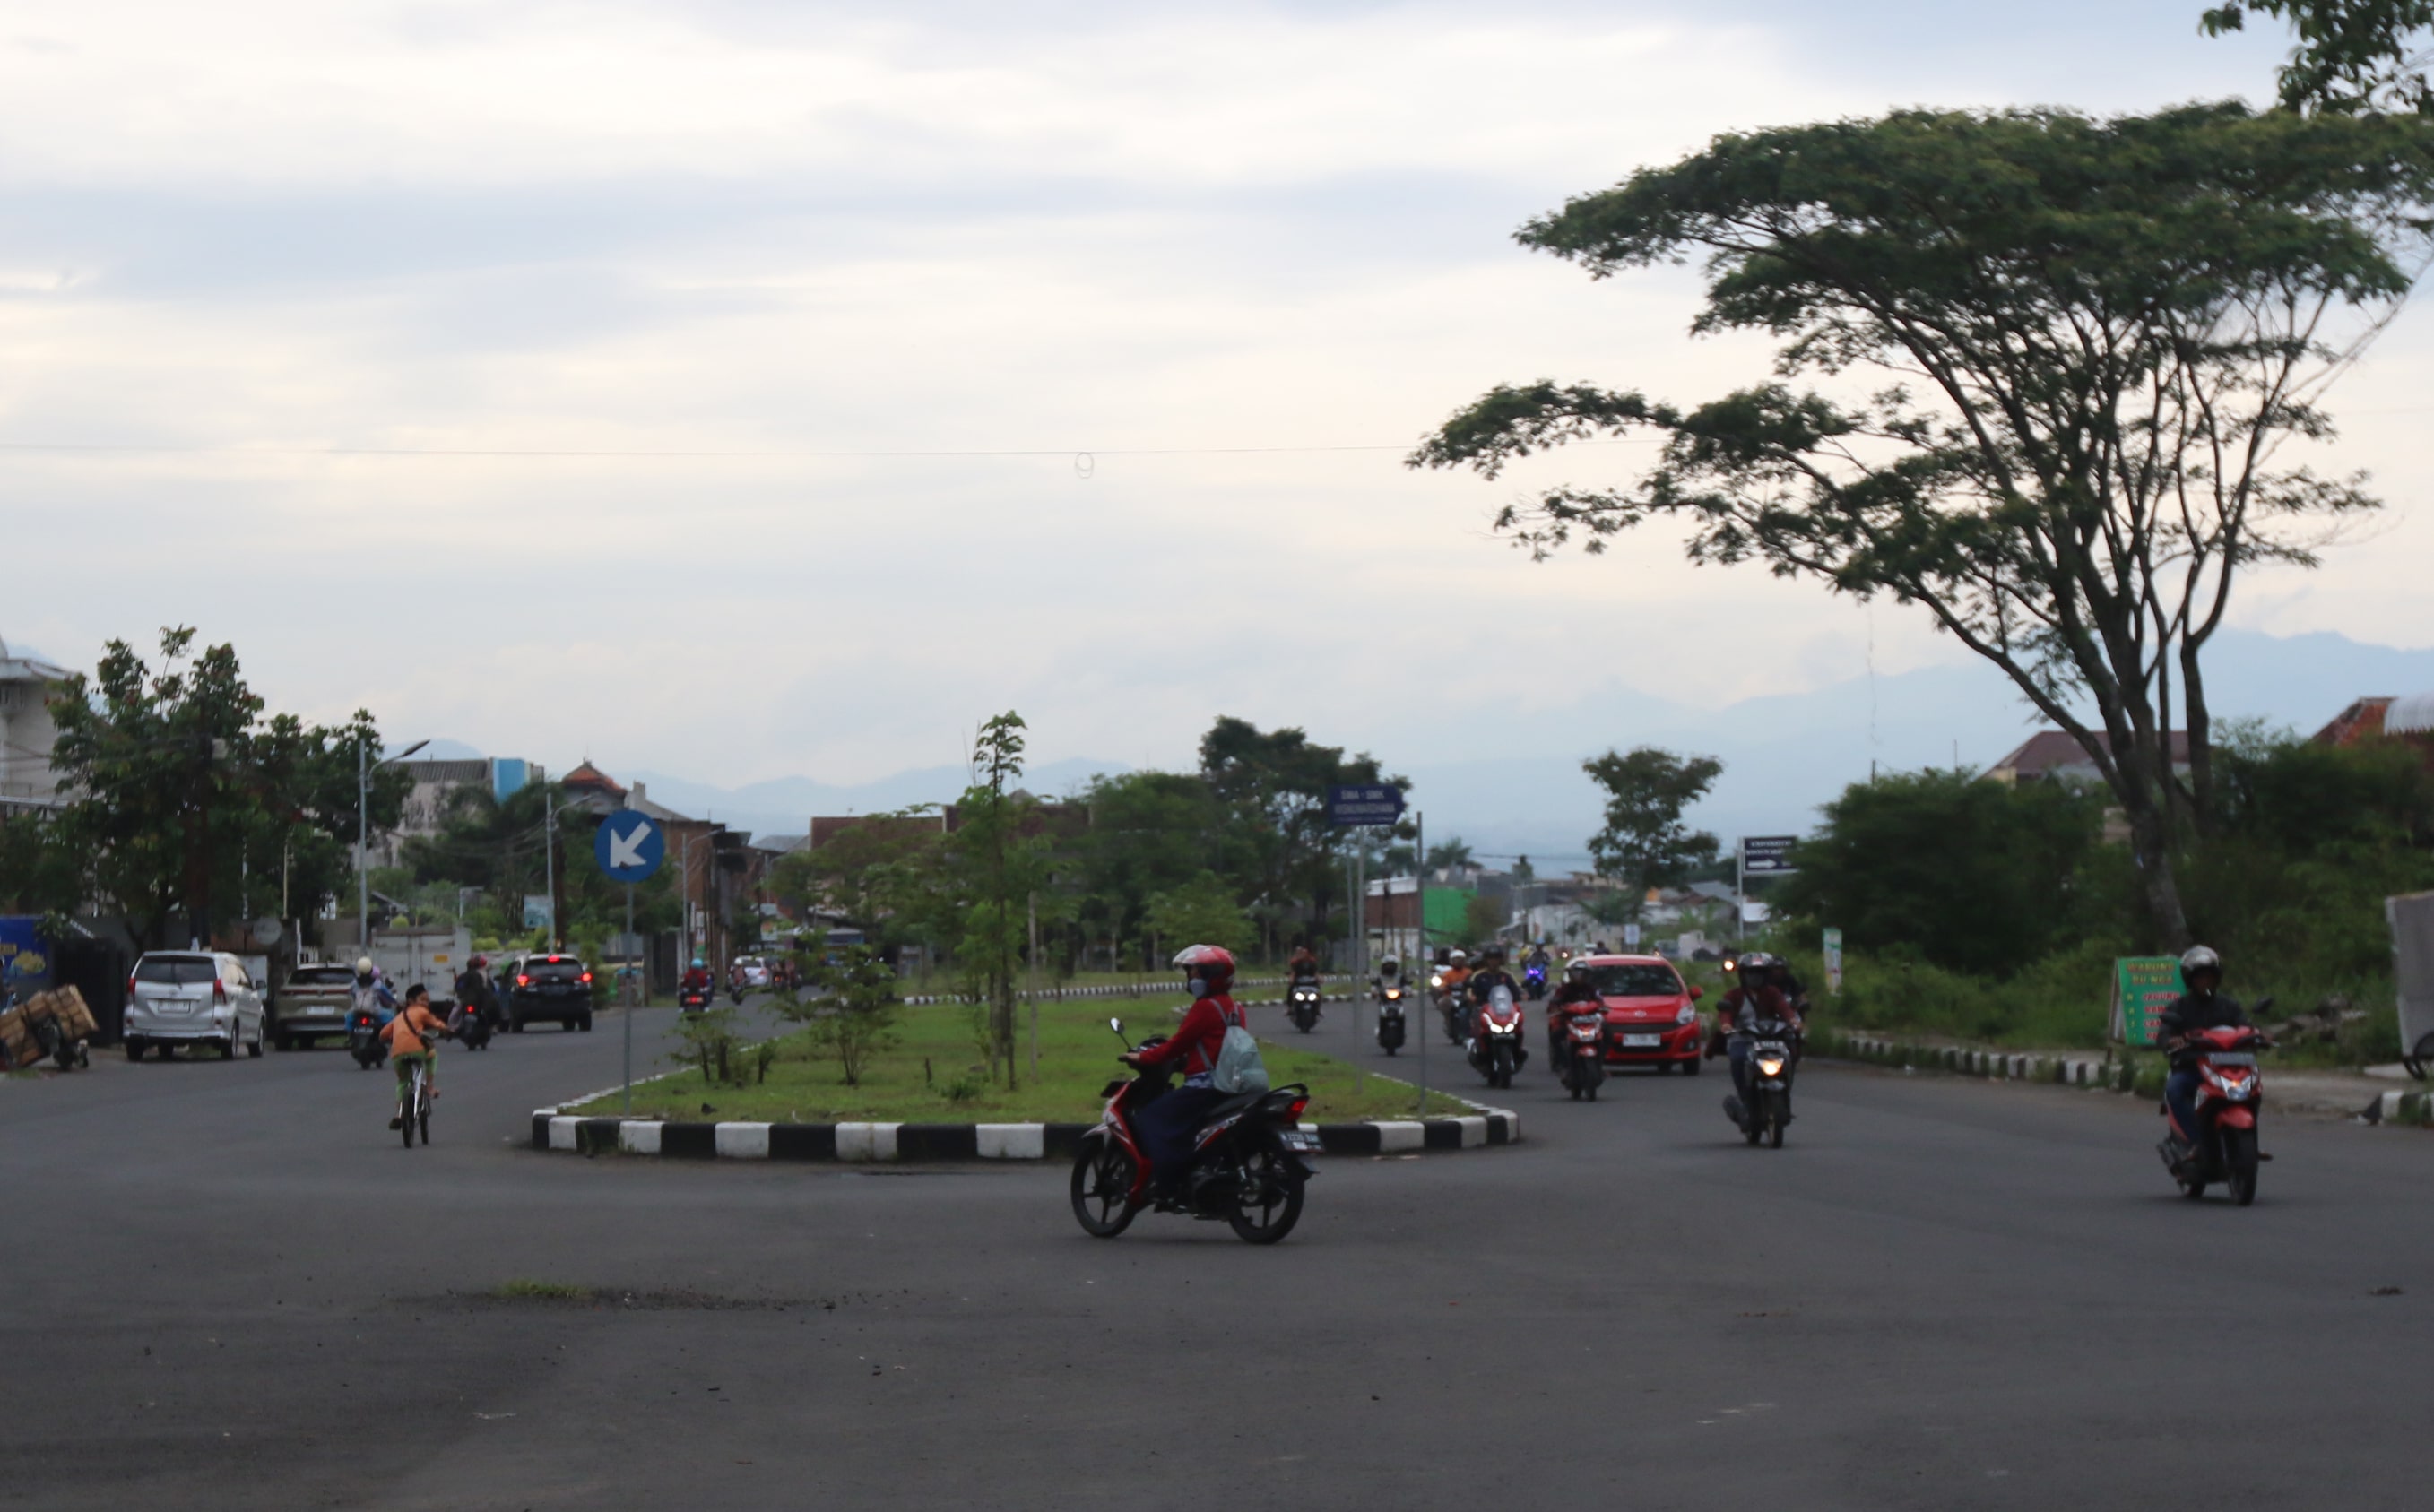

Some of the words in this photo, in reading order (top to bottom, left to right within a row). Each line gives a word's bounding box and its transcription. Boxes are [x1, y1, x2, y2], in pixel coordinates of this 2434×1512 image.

[1340, 790, 1360, 800] SMA
[1366, 789, 1385, 800] SMK
[2127, 962, 2175, 972] WARUNG
[2132, 975, 2146, 984] BU
